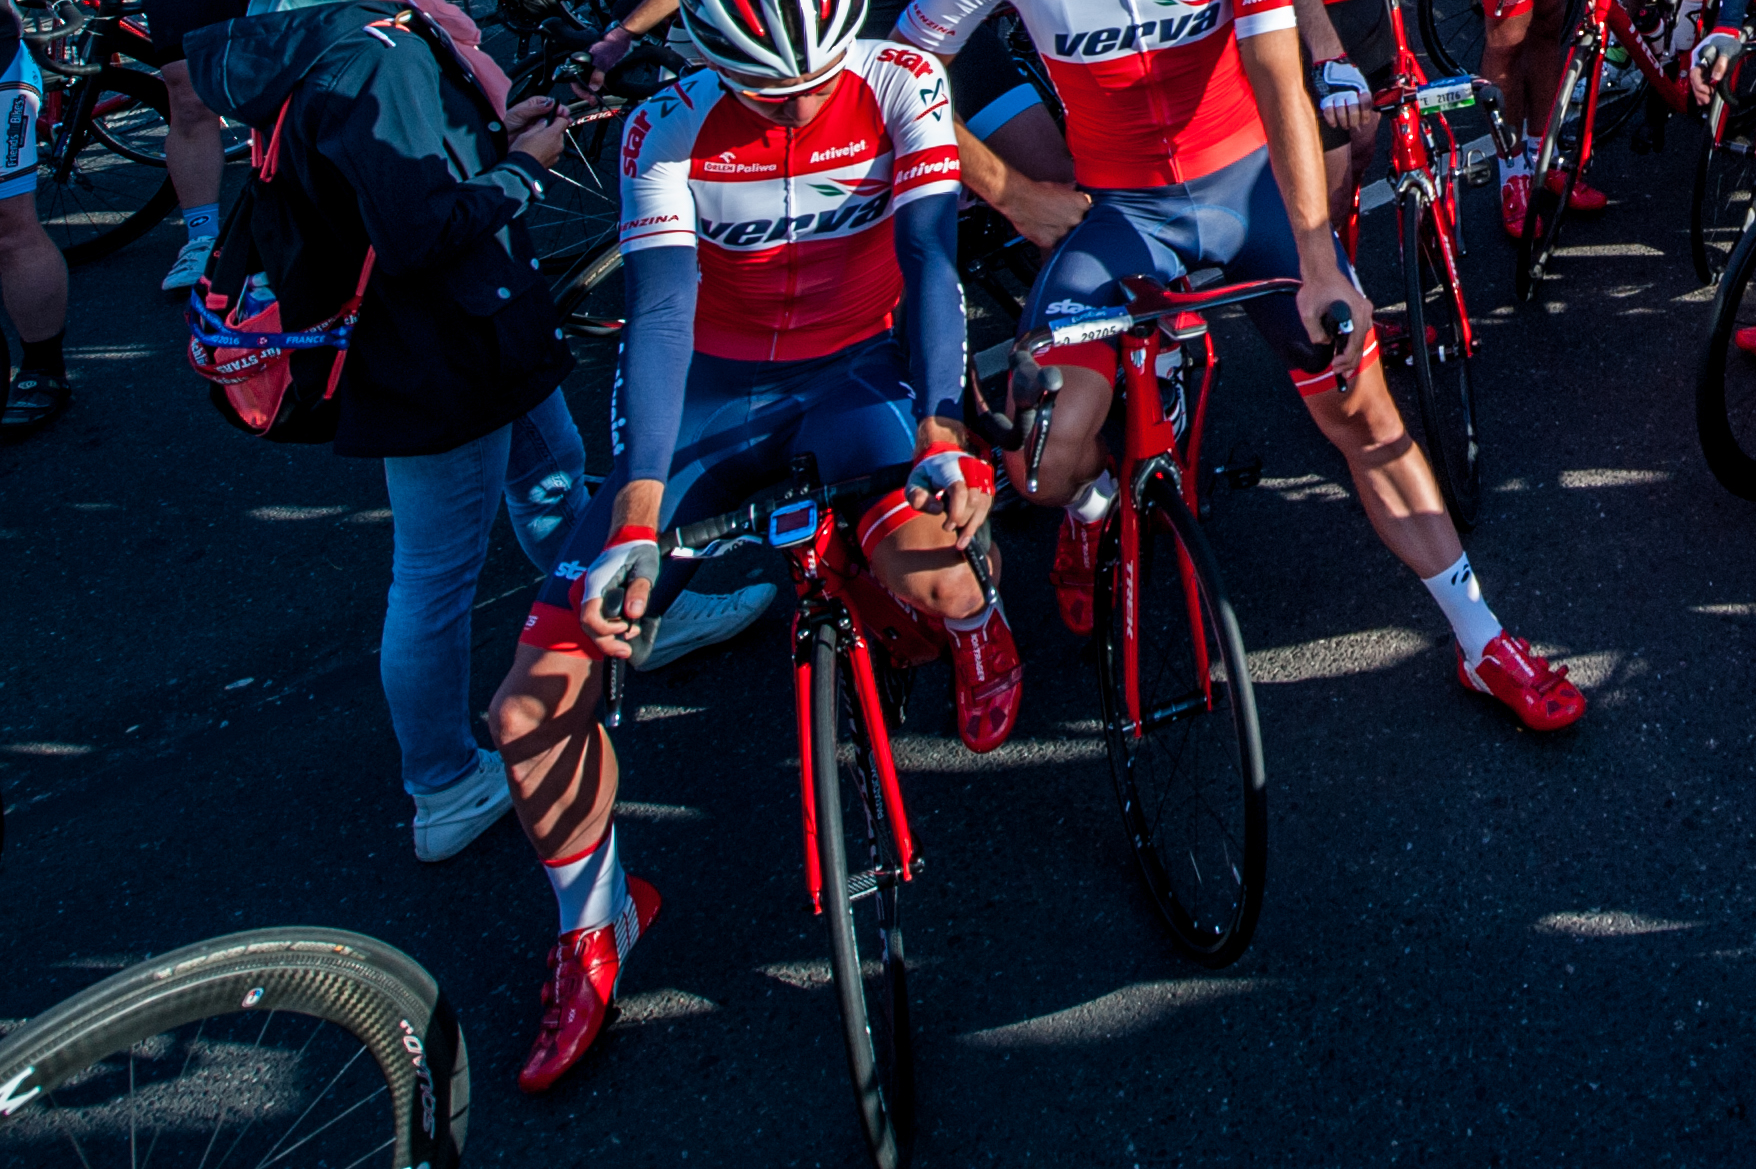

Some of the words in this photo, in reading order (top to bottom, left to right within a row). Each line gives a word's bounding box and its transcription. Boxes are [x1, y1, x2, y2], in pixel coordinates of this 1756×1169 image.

[1054, 3, 1221, 58] verva
[877, 47, 935, 80] star
[1437, 91, 1461, 103] 21776
[623, 109, 652, 179] star
[809, 139, 867, 163] Activejet
[736, 162, 777, 174] Paliwa
[700, 189, 892, 248] verva
[285, 334, 326, 345] FRANCE
[1126, 559, 1135, 641] TREK
